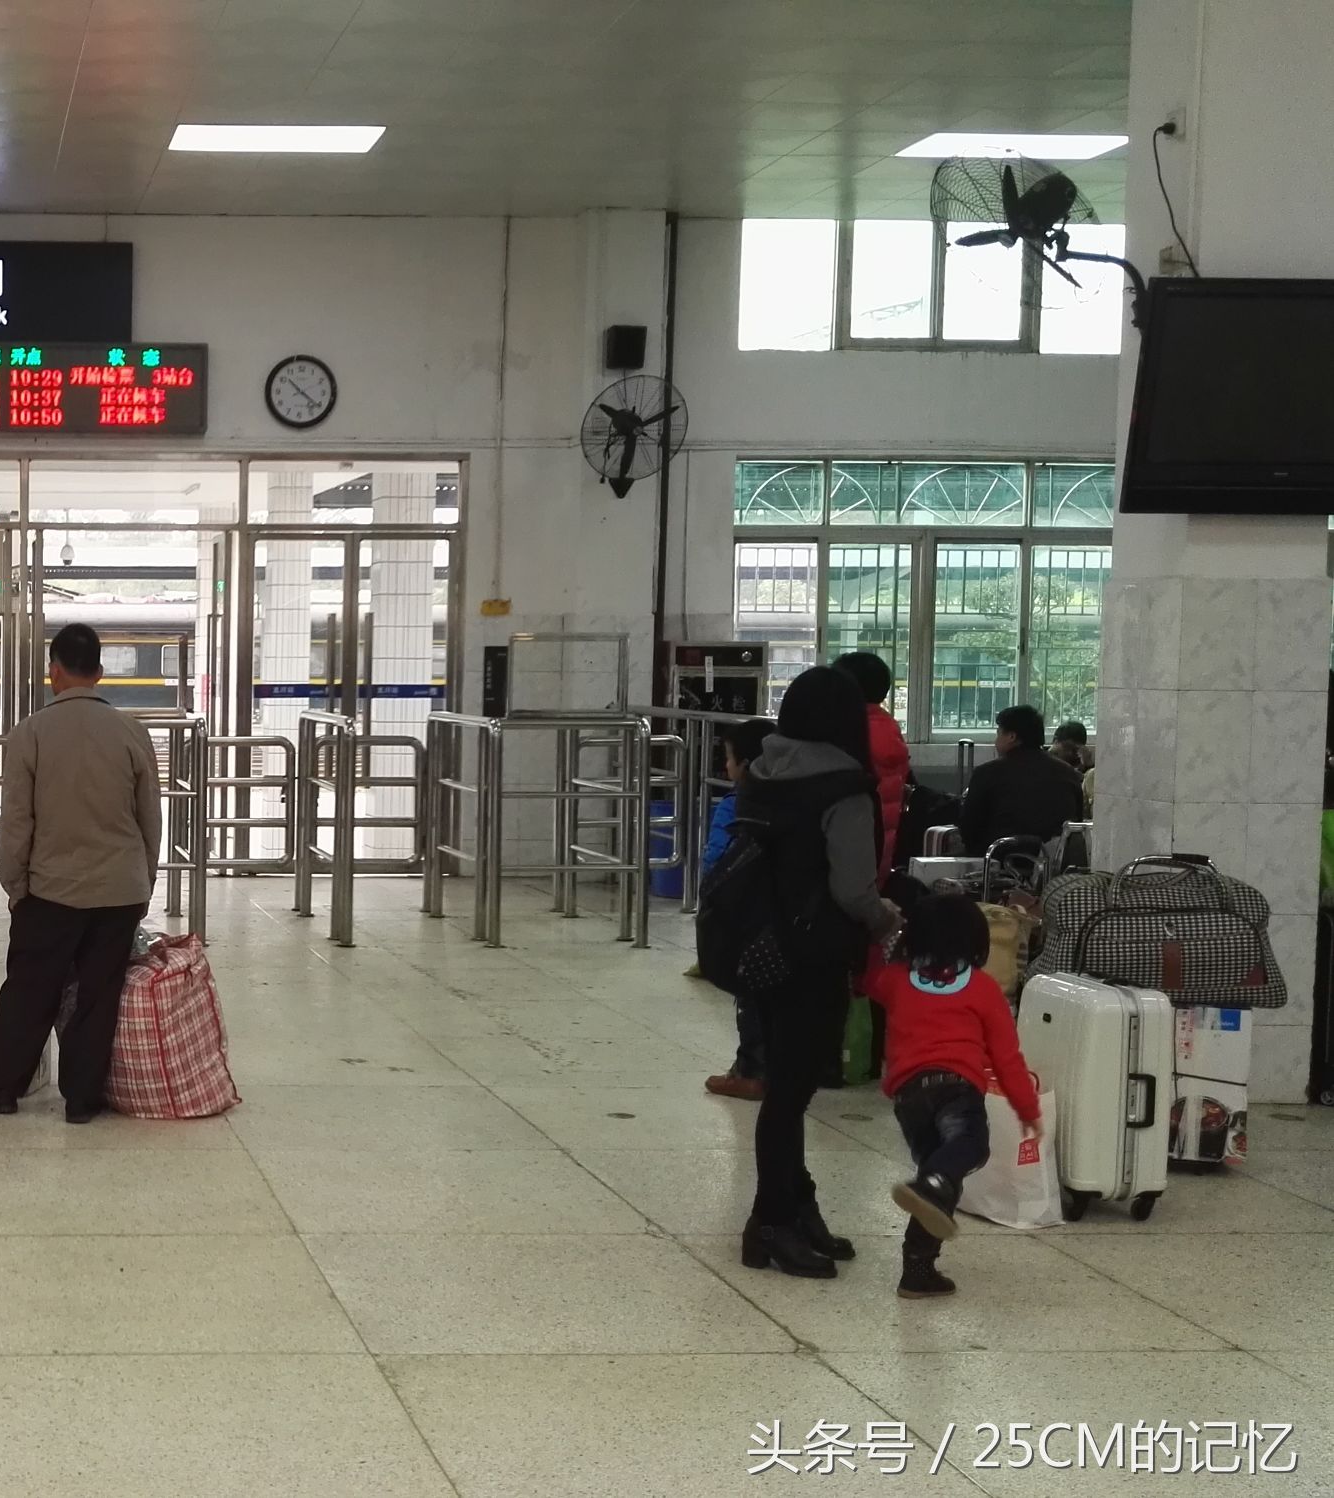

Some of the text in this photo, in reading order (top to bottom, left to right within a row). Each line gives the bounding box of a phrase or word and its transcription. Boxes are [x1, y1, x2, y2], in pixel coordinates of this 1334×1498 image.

[11, 369, 63, 386] 10:29
[11, 389, 62, 406] 10:37
[11, 409, 63, 426] 10:50
